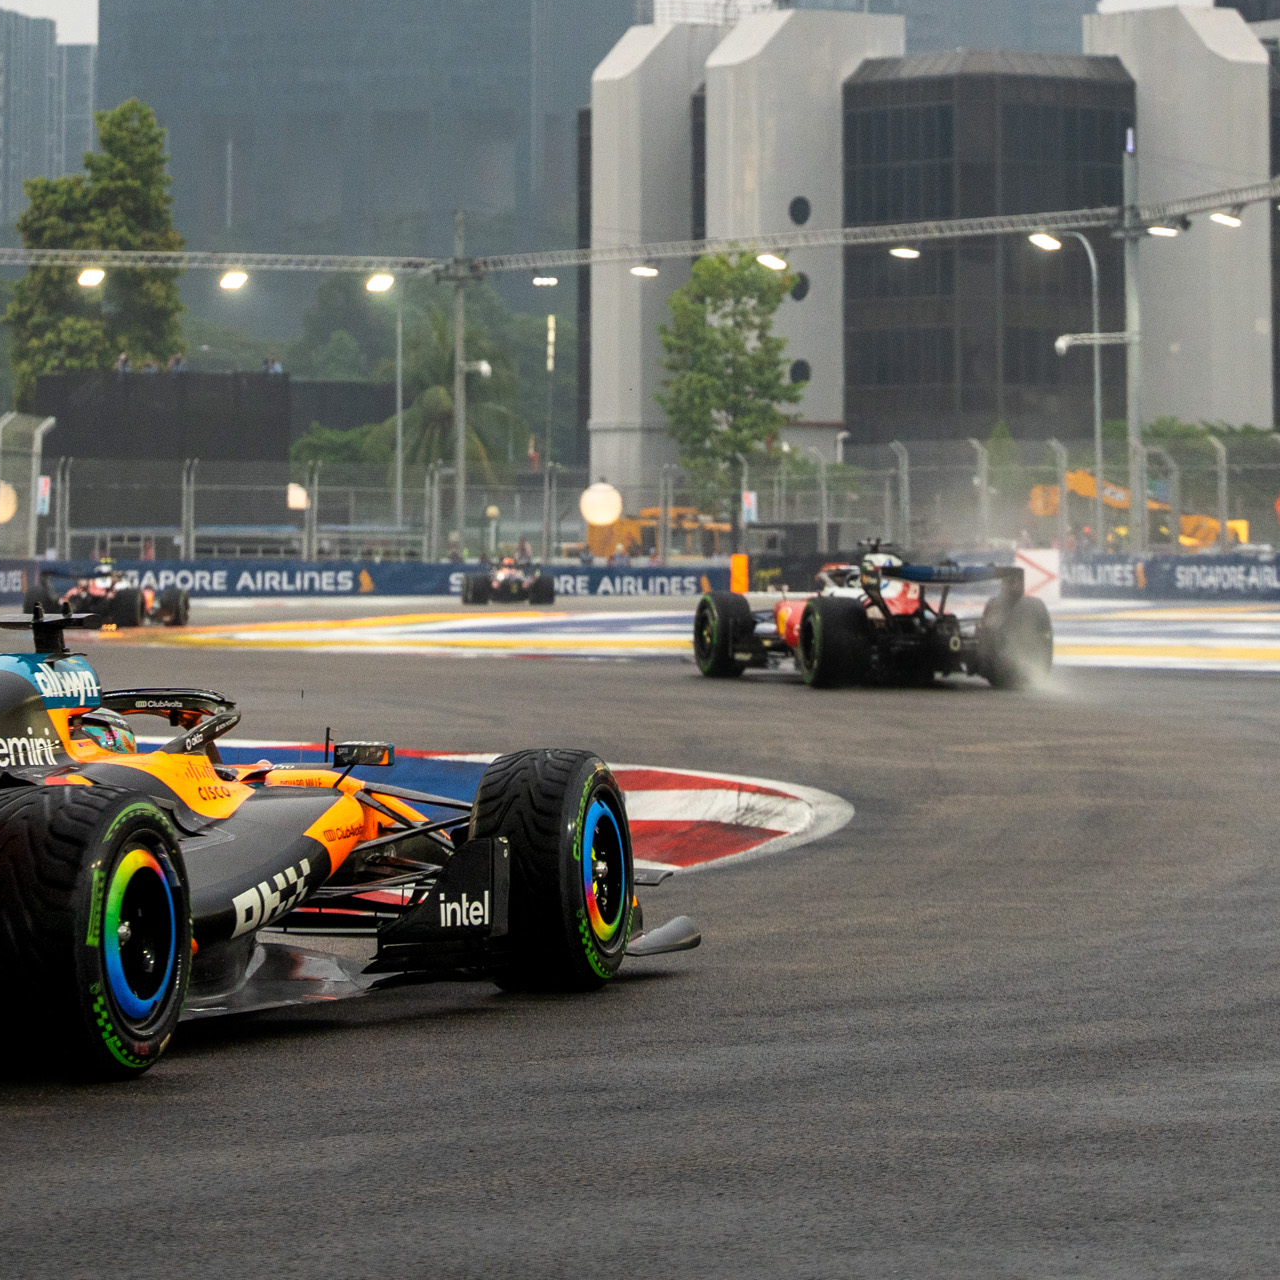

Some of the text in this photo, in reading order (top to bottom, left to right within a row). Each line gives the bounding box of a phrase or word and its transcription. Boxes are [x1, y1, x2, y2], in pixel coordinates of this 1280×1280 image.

[236, 570, 354, 591] AIRLINES
[597, 574, 698, 596] AIRLINES
[34, 662, 99, 706] allwyn
[198, 786, 231, 801] CISCO
[439, 890, 490, 928] intel
